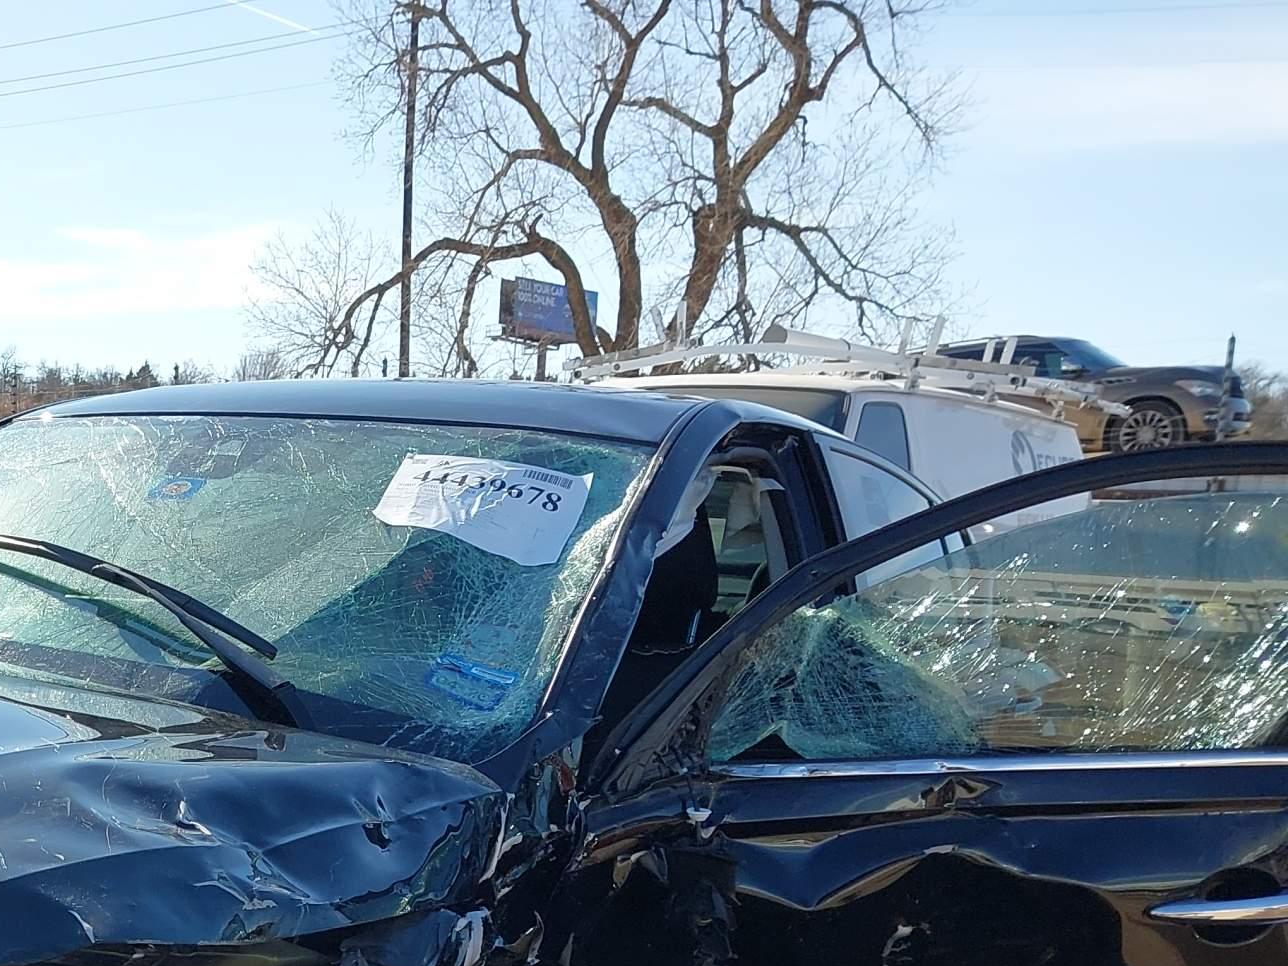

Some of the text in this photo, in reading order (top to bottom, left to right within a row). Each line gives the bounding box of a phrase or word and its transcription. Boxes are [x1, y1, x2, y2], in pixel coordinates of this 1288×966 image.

[533, 283, 550, 294] YOUR
[551, 285, 565, 297] CAR
[533, 294, 556, 307] ONLINE
[413, 470, 562, 512] 44439678
